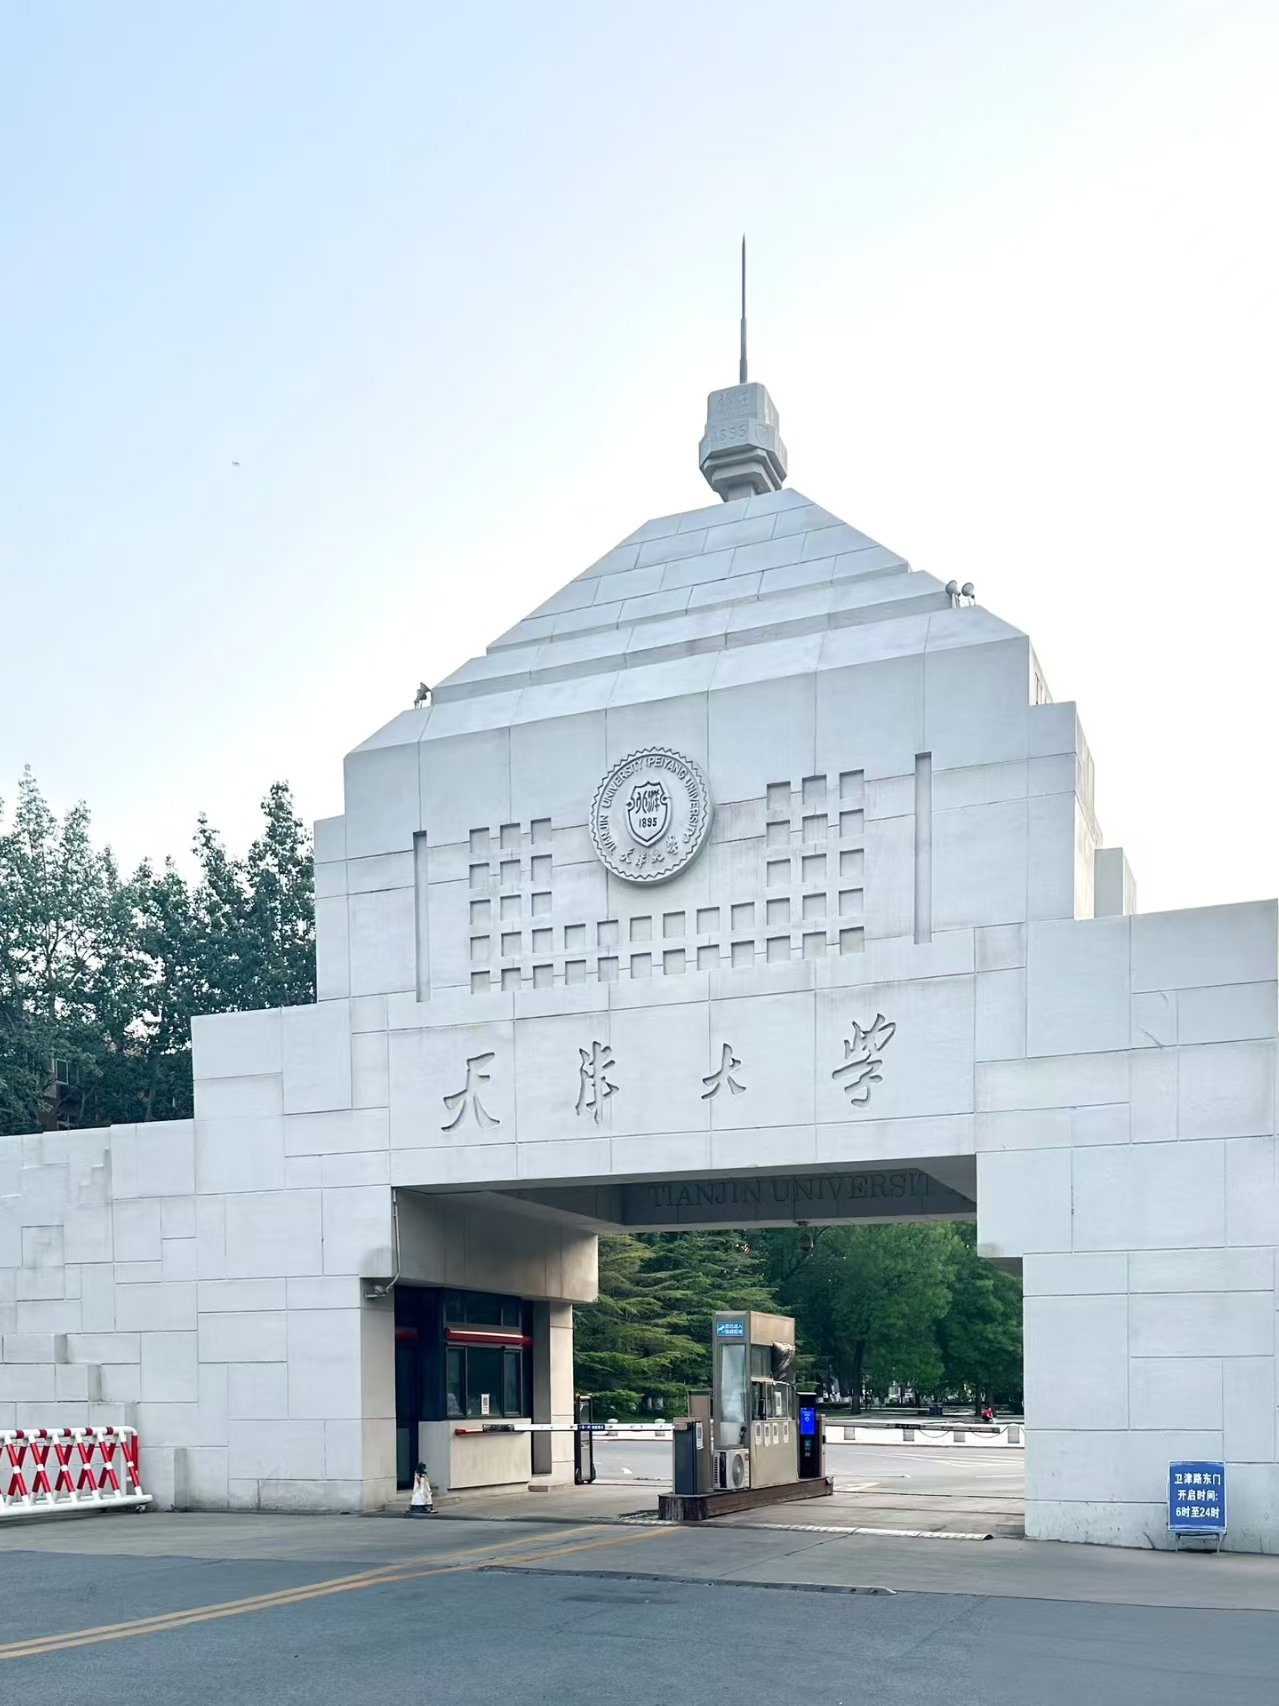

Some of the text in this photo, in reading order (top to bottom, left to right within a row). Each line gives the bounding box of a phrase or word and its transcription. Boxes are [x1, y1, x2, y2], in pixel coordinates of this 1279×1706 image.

[602, 761, 643, 808] UNIVERSITY
[638, 817, 658, 829] 1895
[440, 1013, 897, 1134] 天津大学
[648, 1180, 760, 1207] TIANJIN
[1174, 1473, 1221, 1485] 卫津路东门
[1176, 1506, 1219, 1518] 6时至24时
